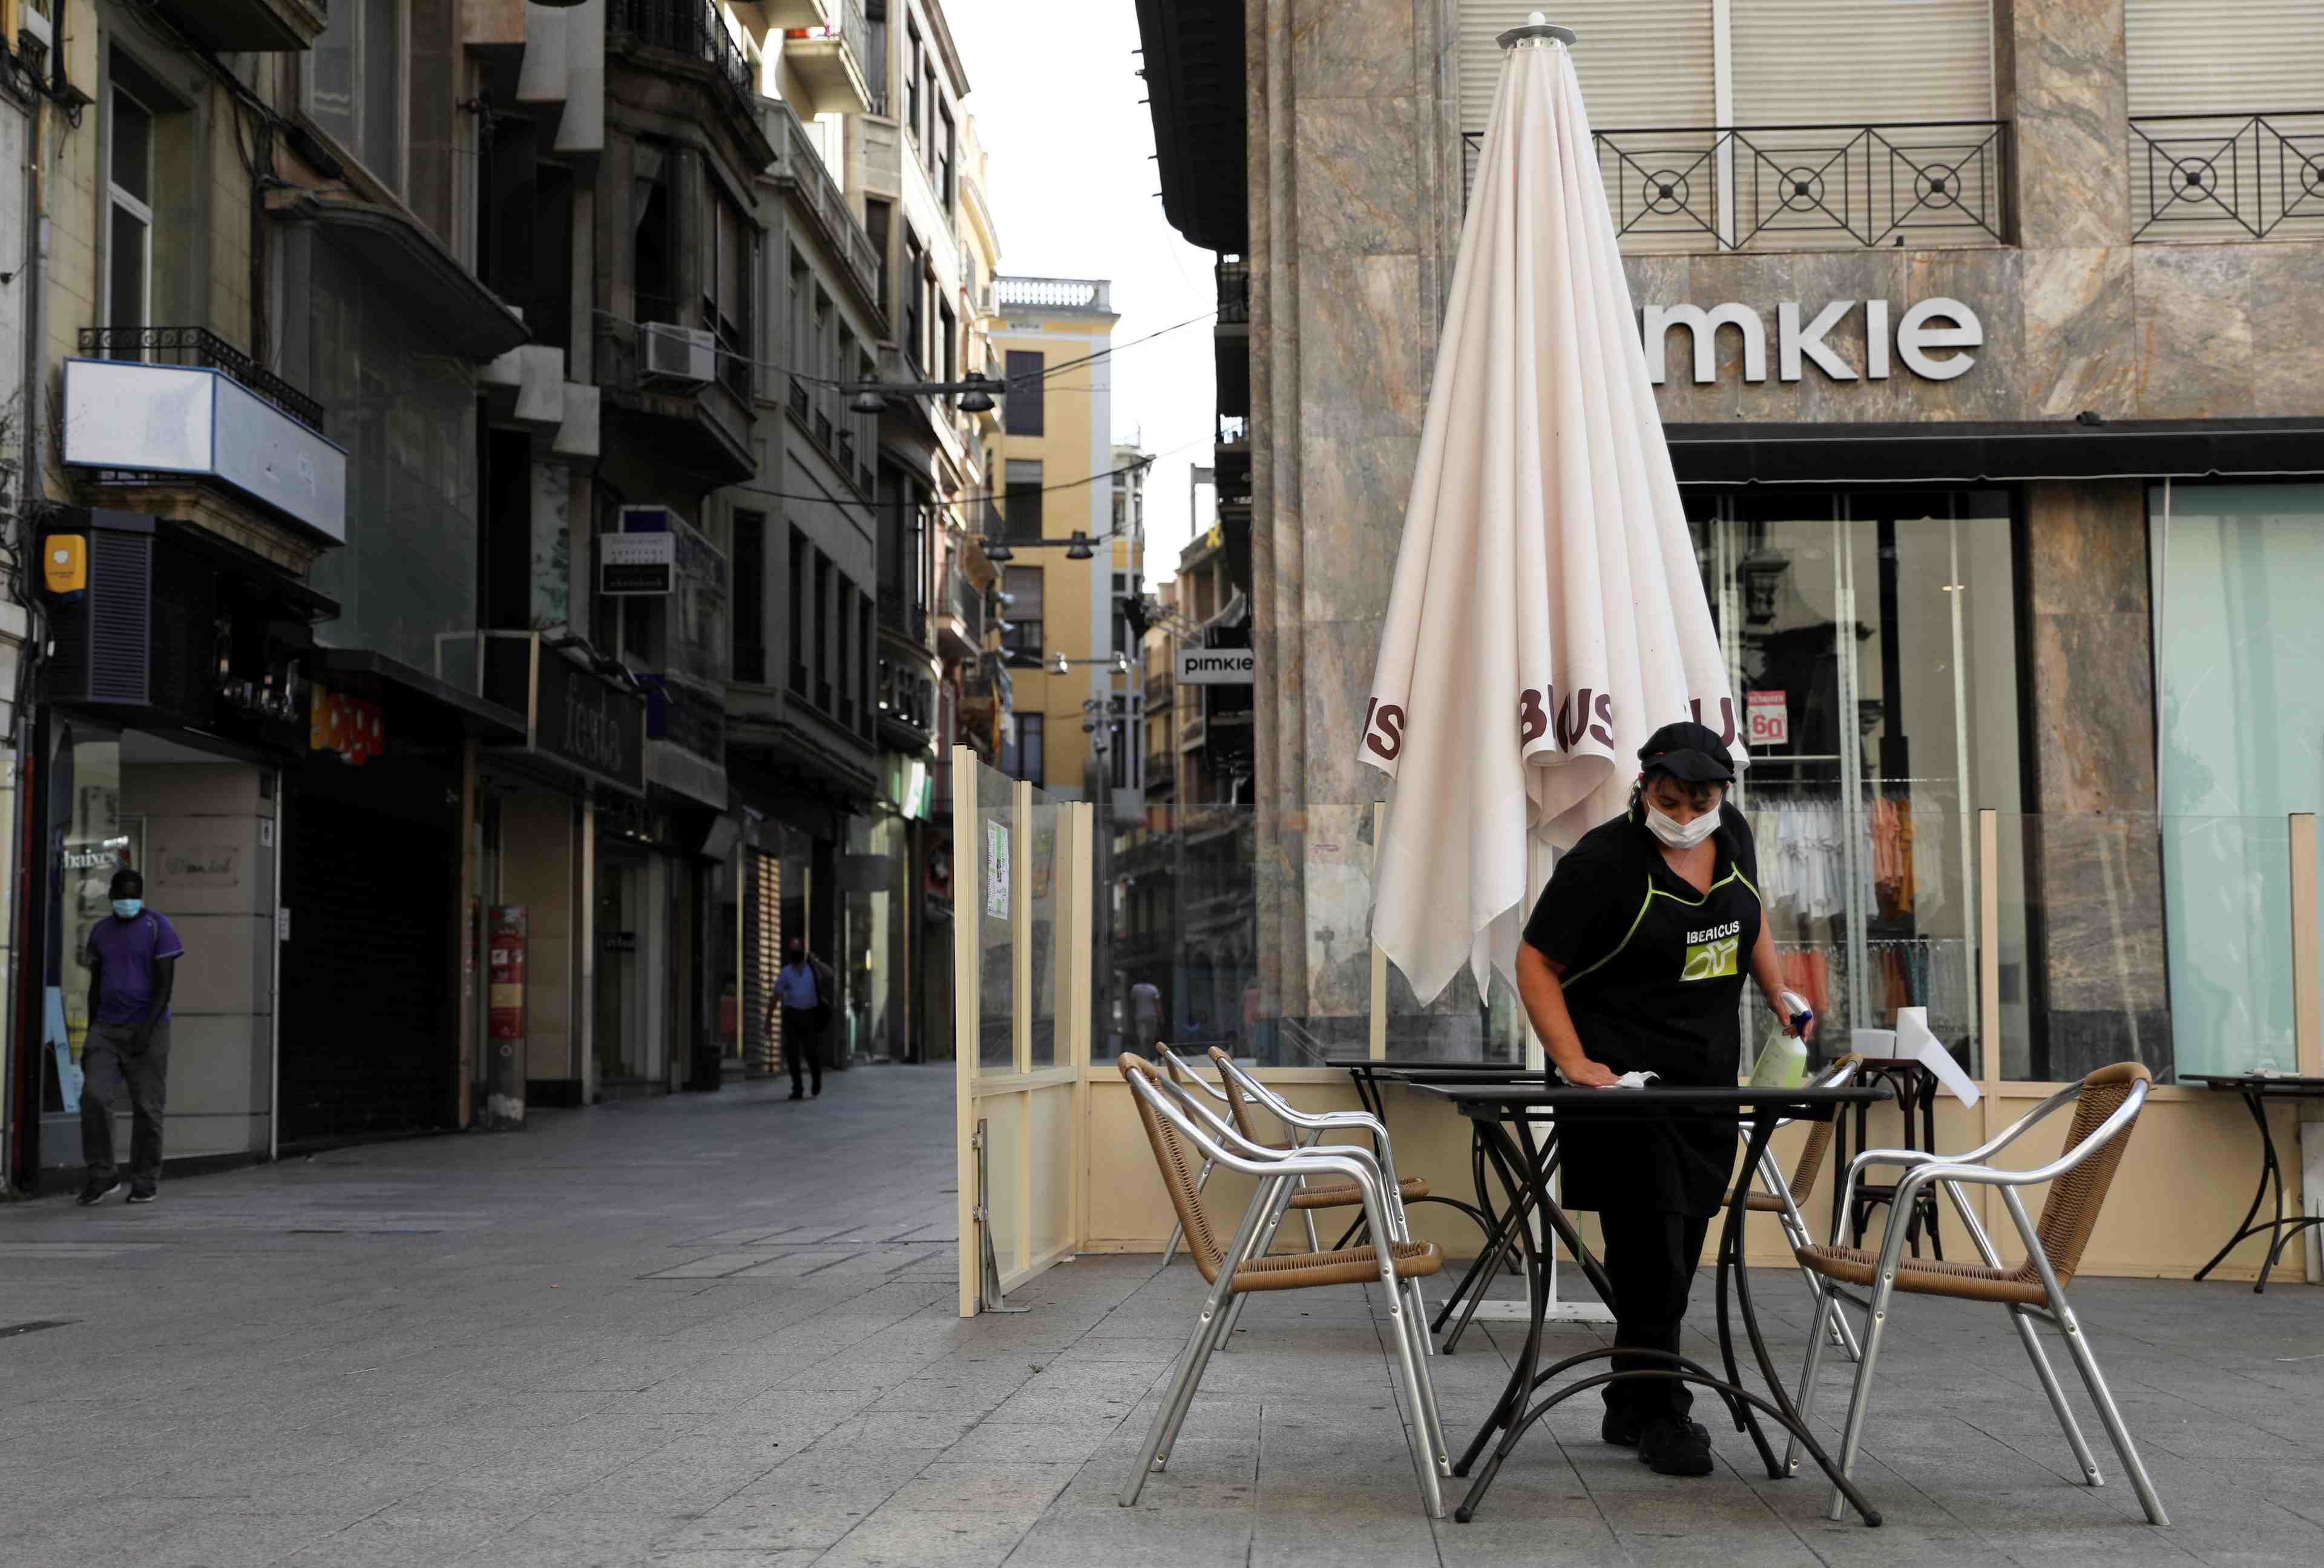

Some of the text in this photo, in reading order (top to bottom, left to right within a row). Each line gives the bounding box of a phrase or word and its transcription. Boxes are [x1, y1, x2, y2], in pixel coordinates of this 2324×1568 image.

[1641, 297, 1984, 384] mkie
[1185, 658, 1253, 675] pimkie
[1752, 713, 1782, 738] 60
[1686, 920, 1740, 945] IBERICUS
